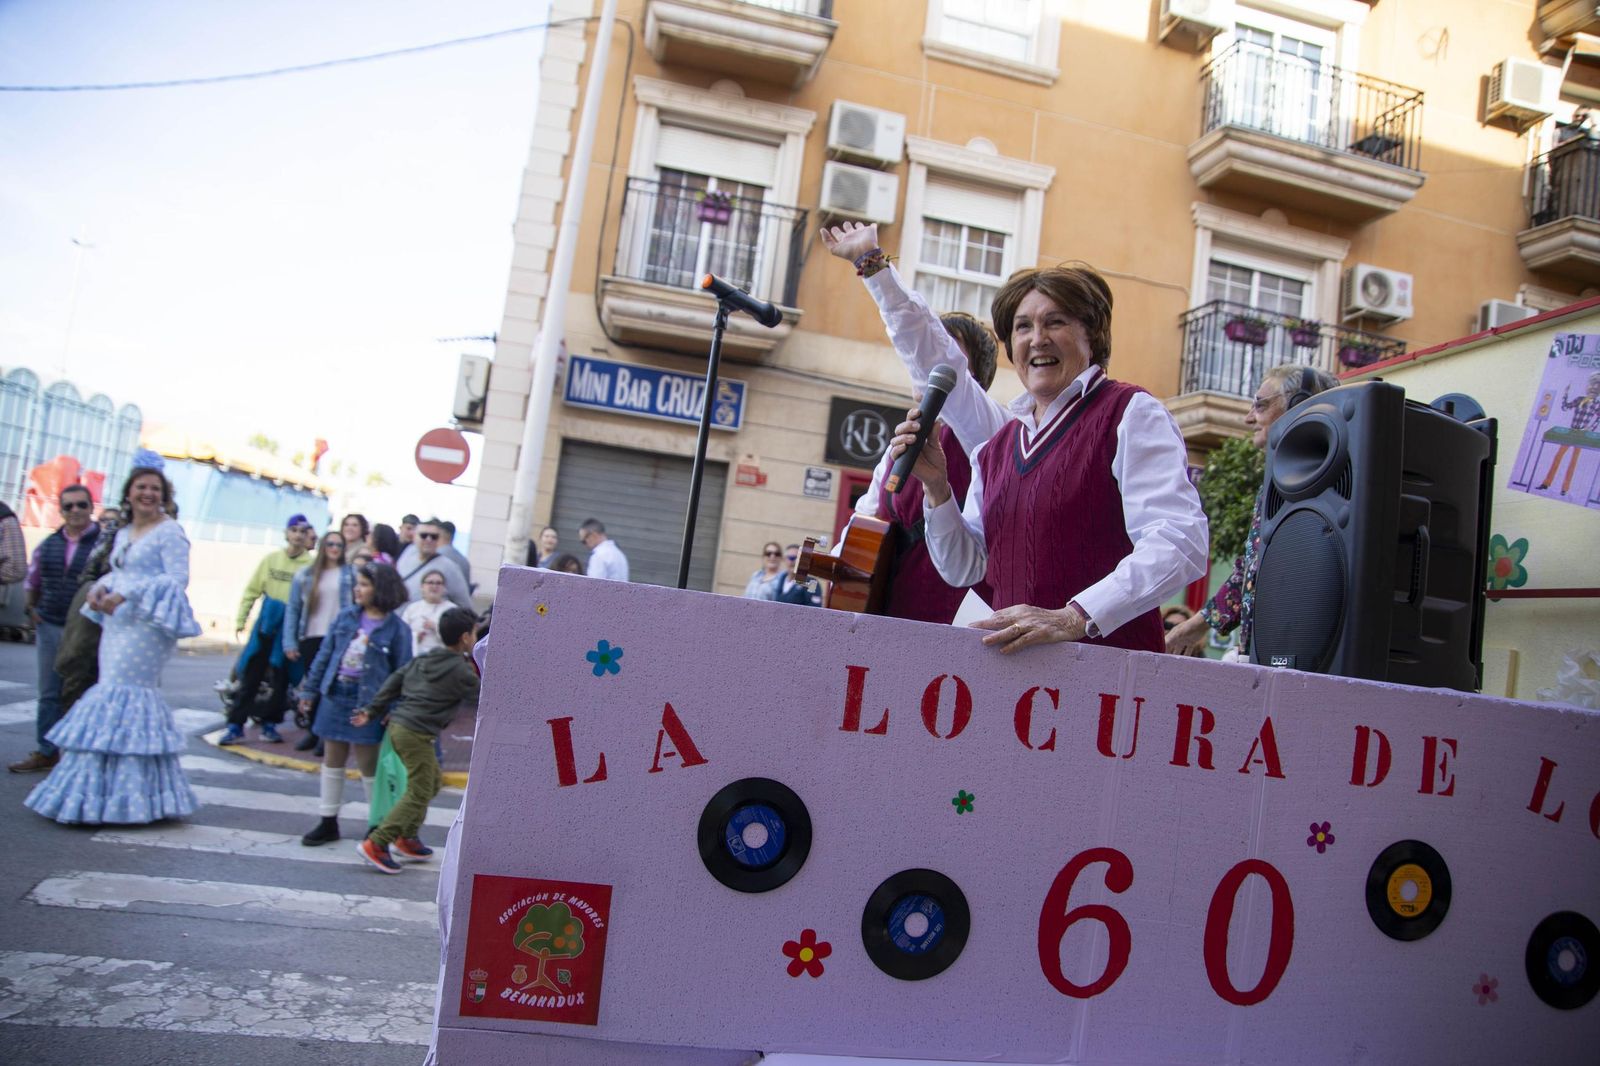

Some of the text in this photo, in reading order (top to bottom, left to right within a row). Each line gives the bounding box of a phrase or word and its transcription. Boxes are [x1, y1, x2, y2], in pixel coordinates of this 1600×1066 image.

[546, 701, 709, 787] LA
[838, 665, 1286, 779] LOCURA
[1348, 724, 1458, 797] DE
[552, 892, 567, 901] DE
[568, 896, 604, 929] MAYORES
[1037, 846, 1295, 1007] 60
[500, 987, 585, 1008] BENAHADUX
